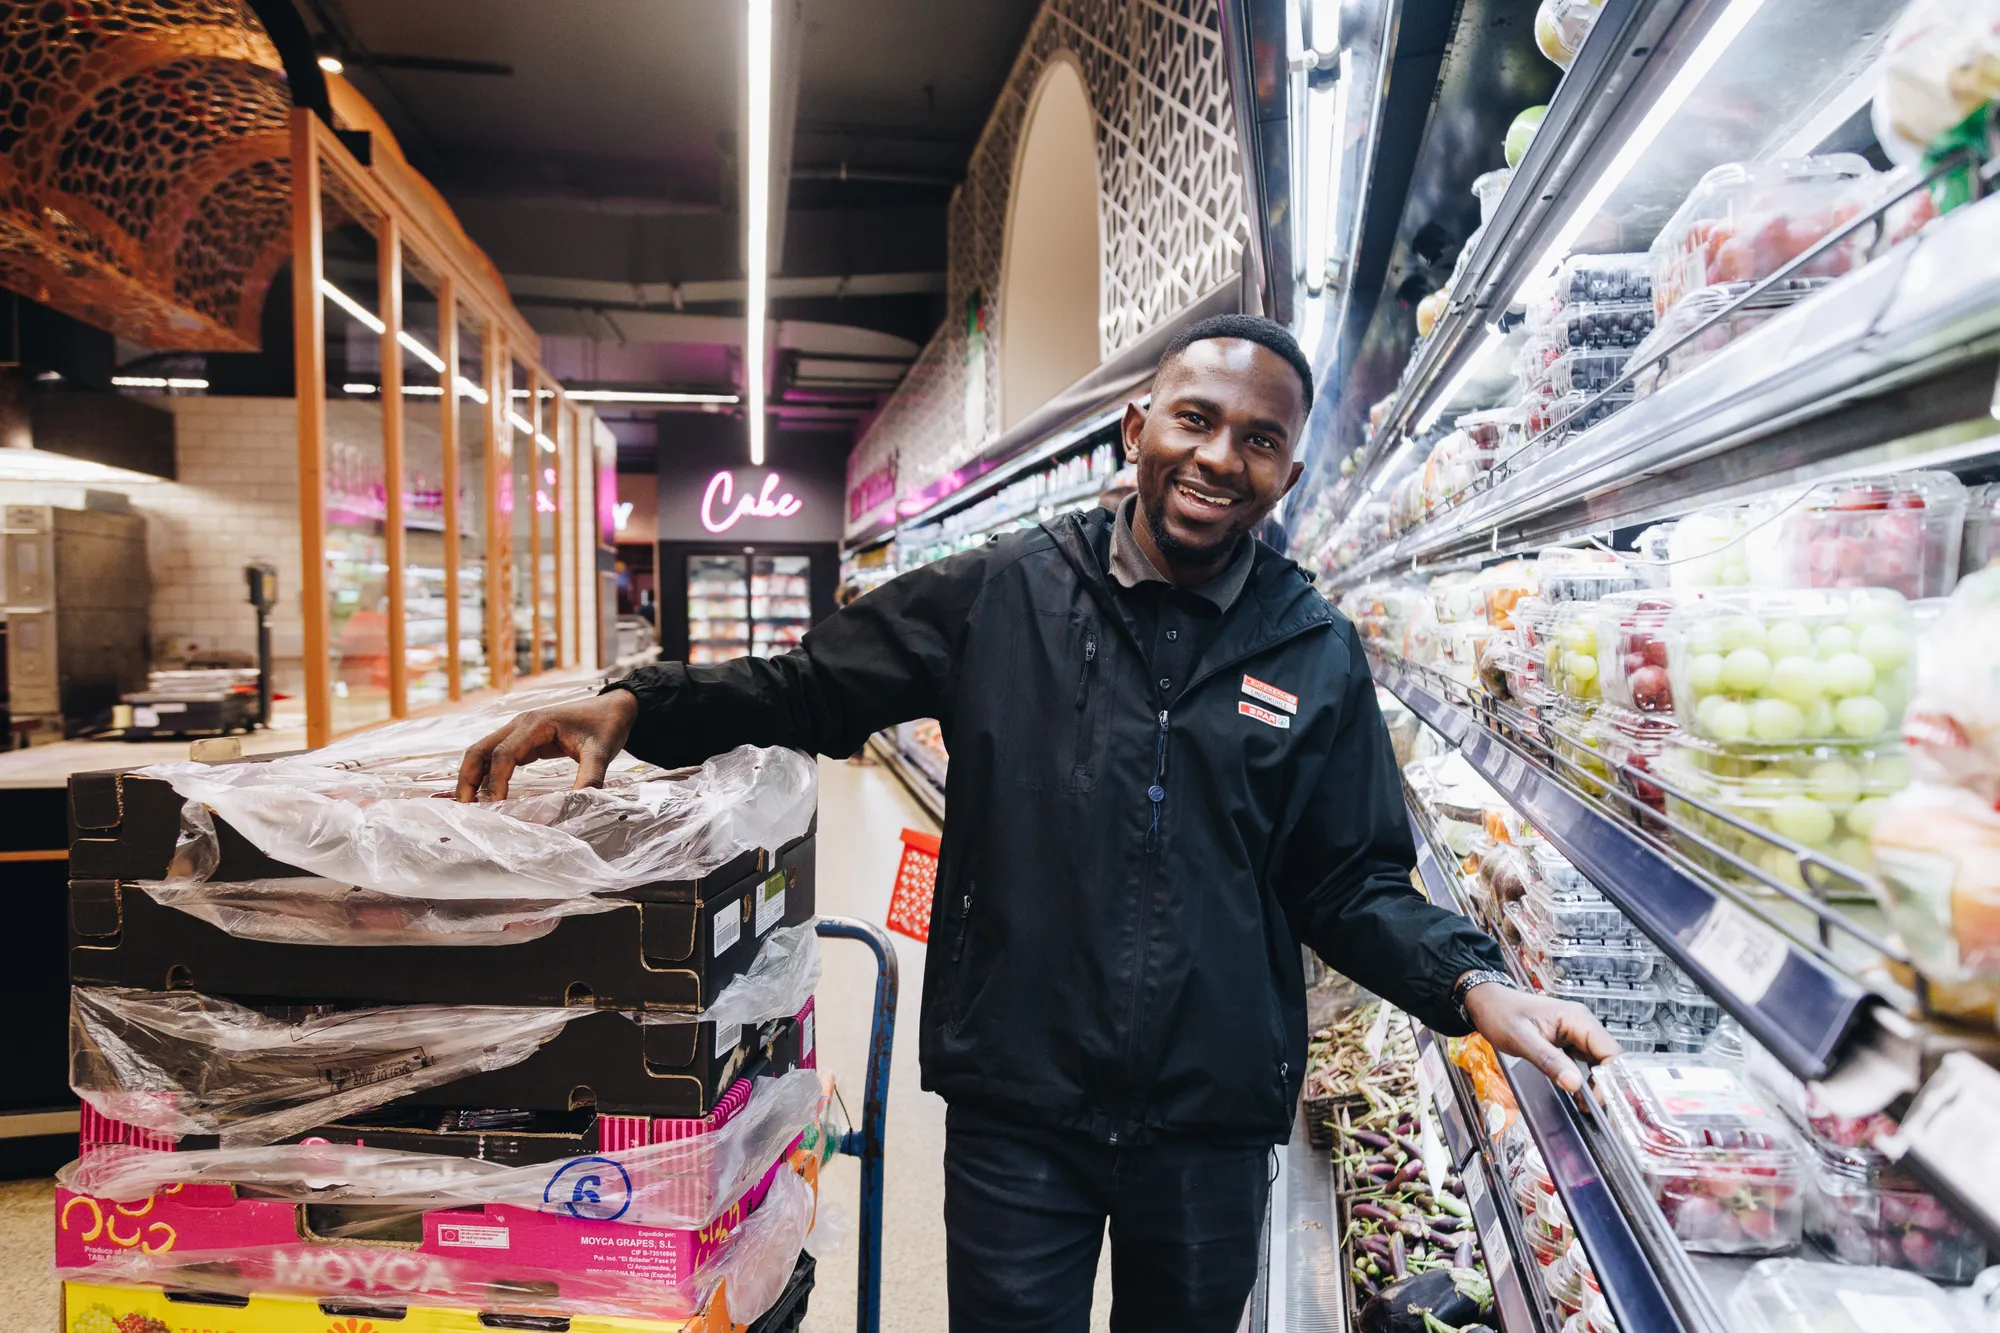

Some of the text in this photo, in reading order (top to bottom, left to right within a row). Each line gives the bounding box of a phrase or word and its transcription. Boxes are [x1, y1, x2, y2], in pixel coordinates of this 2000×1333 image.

[701, 470, 803, 533] Cake
[1249, 707, 1276, 724] SPAR
[84, 1246, 113, 1254] Produce
[581, 1237, 676, 1249] MOYCA GRAPES, S.L.
